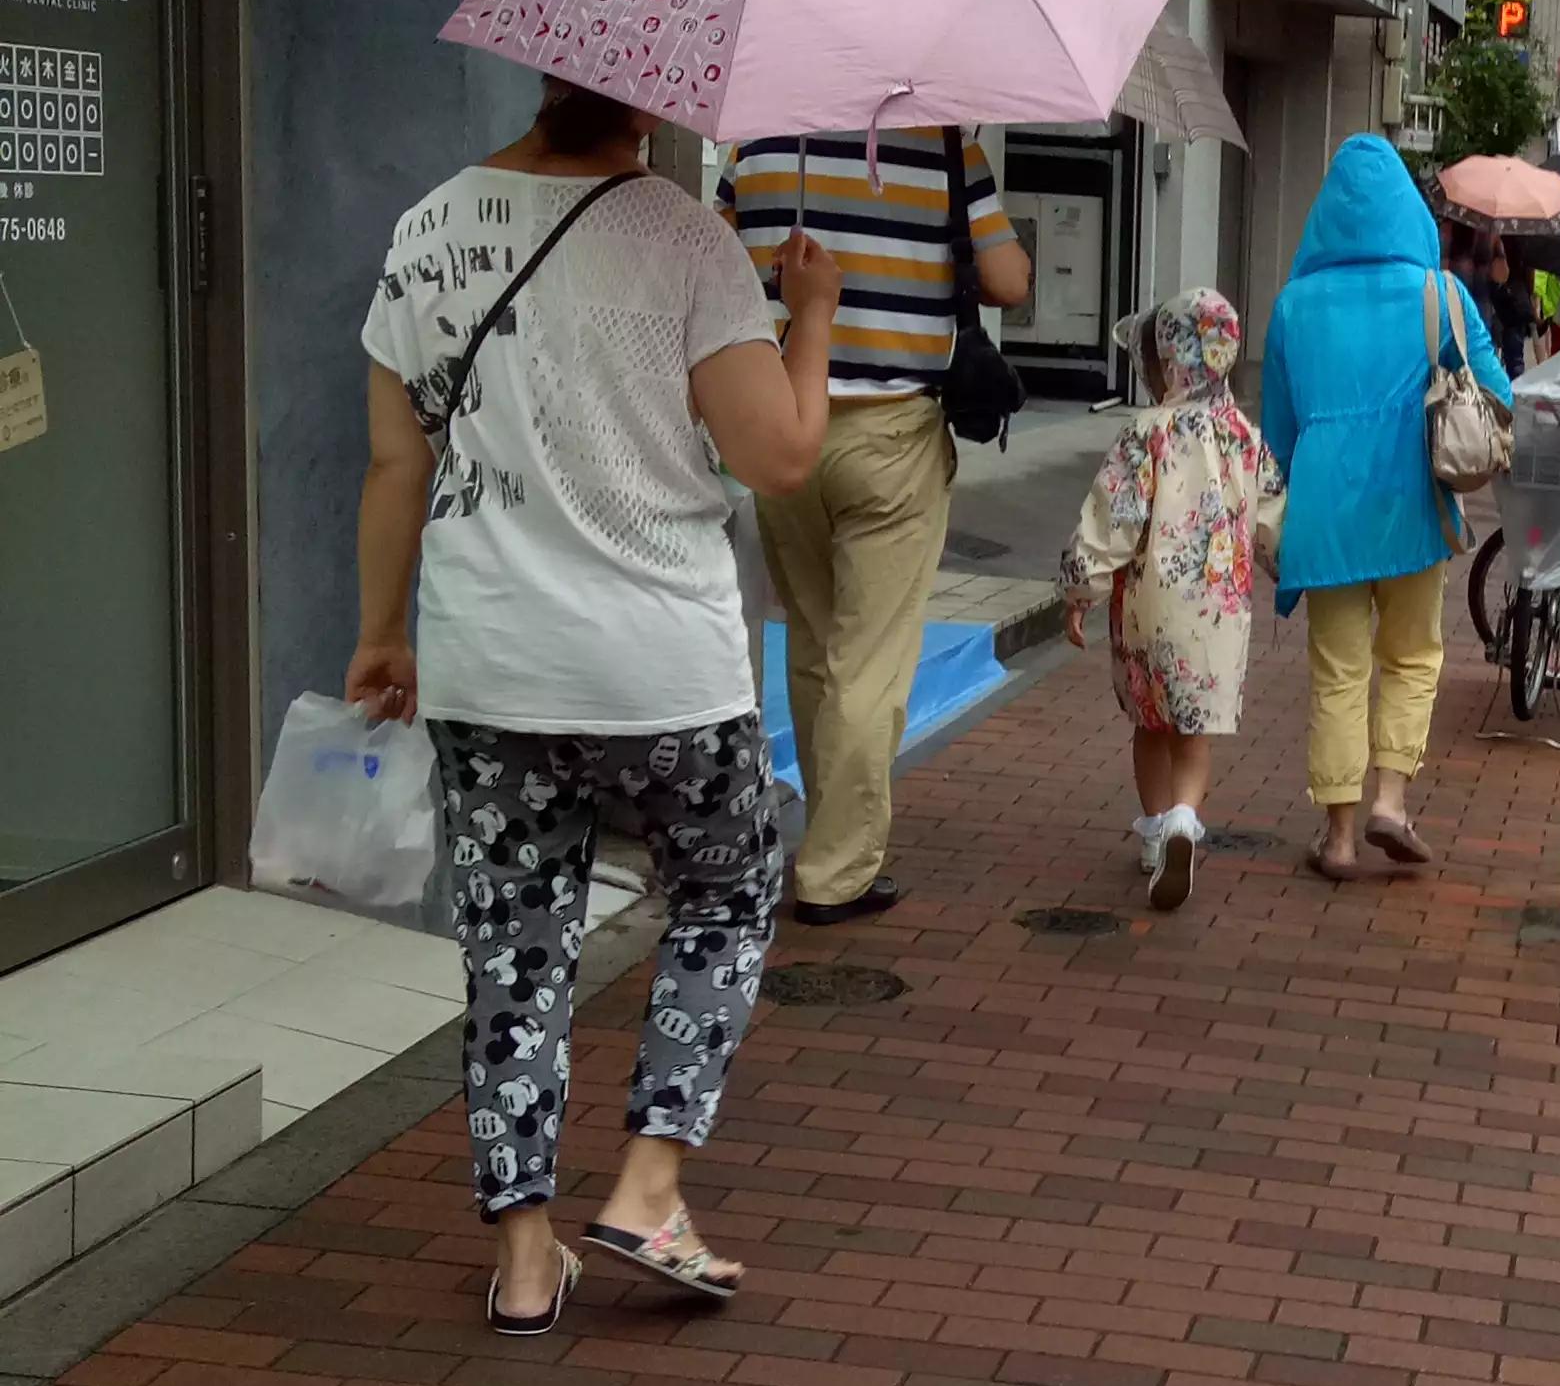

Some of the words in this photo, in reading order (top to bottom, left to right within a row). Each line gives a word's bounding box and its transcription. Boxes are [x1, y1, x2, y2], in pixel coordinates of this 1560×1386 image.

[1500, 0, 1524, 36] P
[20, 56, 33, 78] 水
[42, 58, 54, 80] 木
[64, 60, 76, 82] 金
[85, 62, 97, 83] 土
